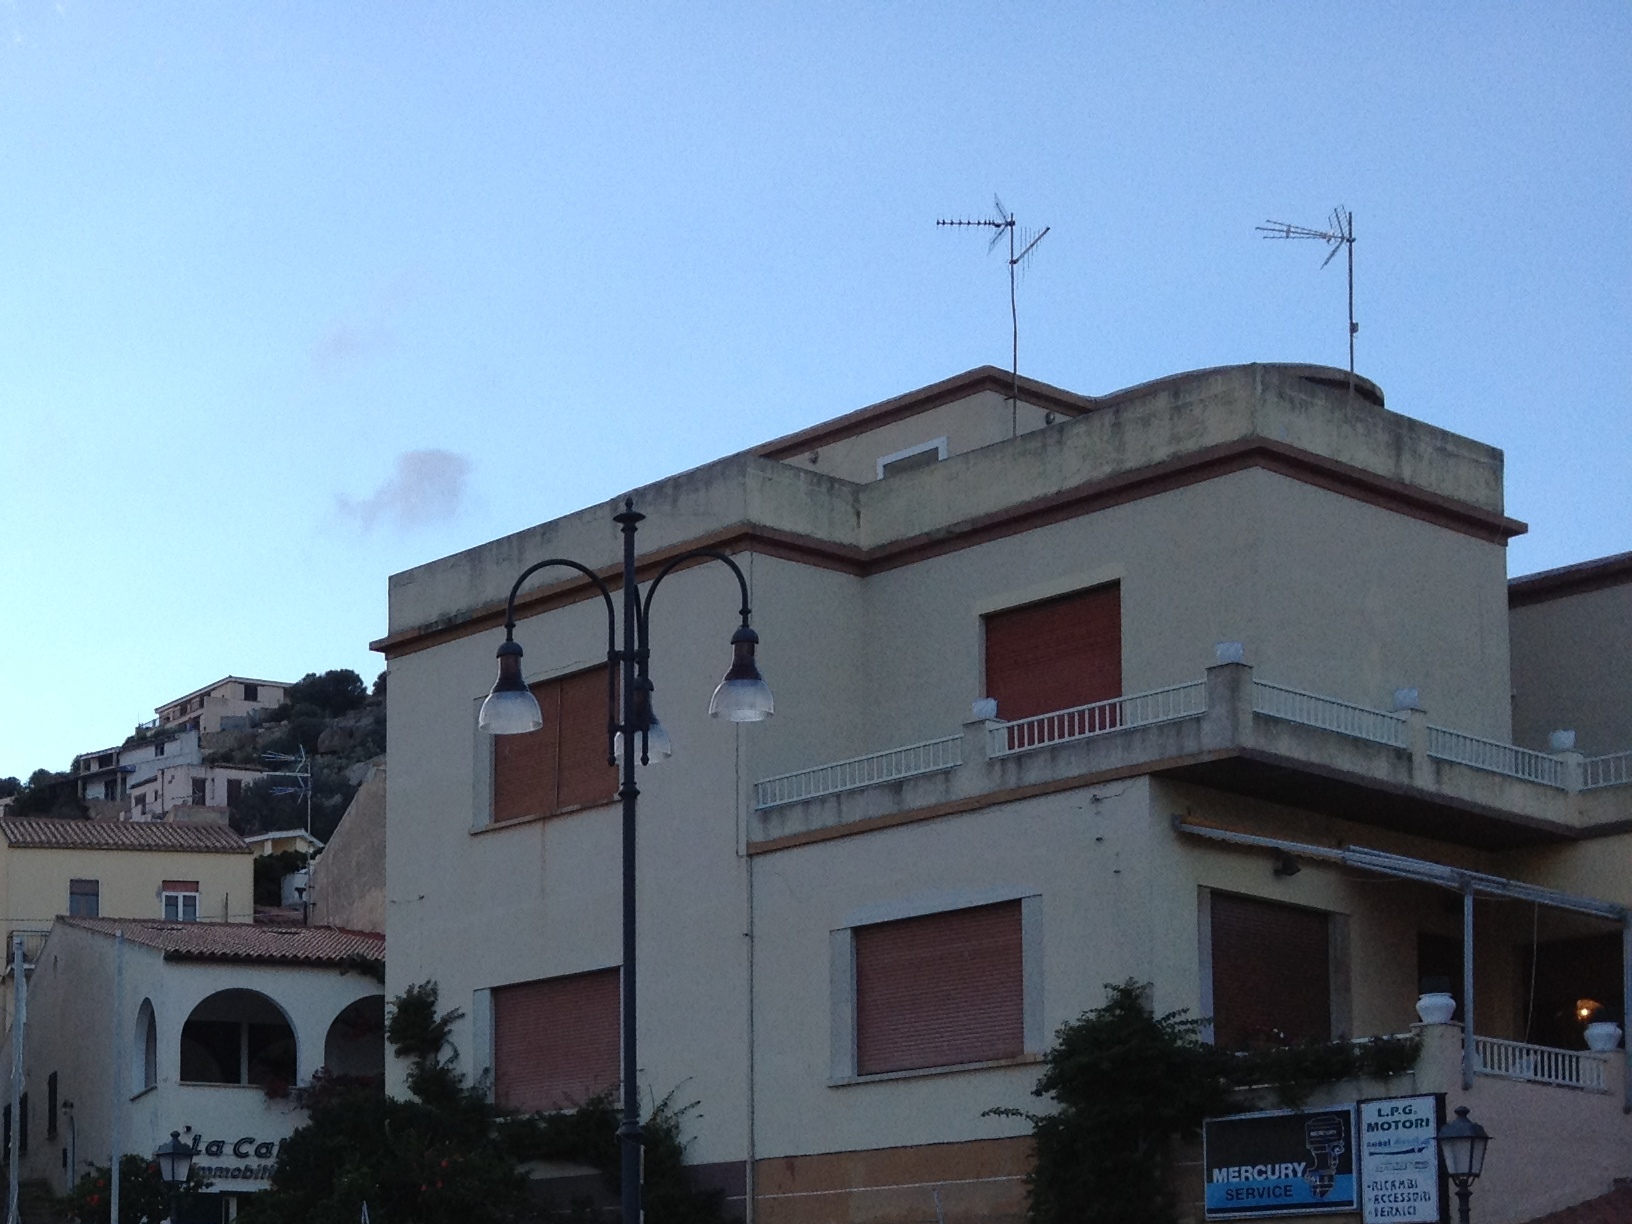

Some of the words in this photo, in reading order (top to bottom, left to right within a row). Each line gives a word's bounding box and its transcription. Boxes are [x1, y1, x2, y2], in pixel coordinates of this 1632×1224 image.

[1366, 1118, 1429, 1133] MOTORI
[1212, 1161, 1307, 1184] MERCURY
[1225, 1184, 1294, 1201] SERVICE
